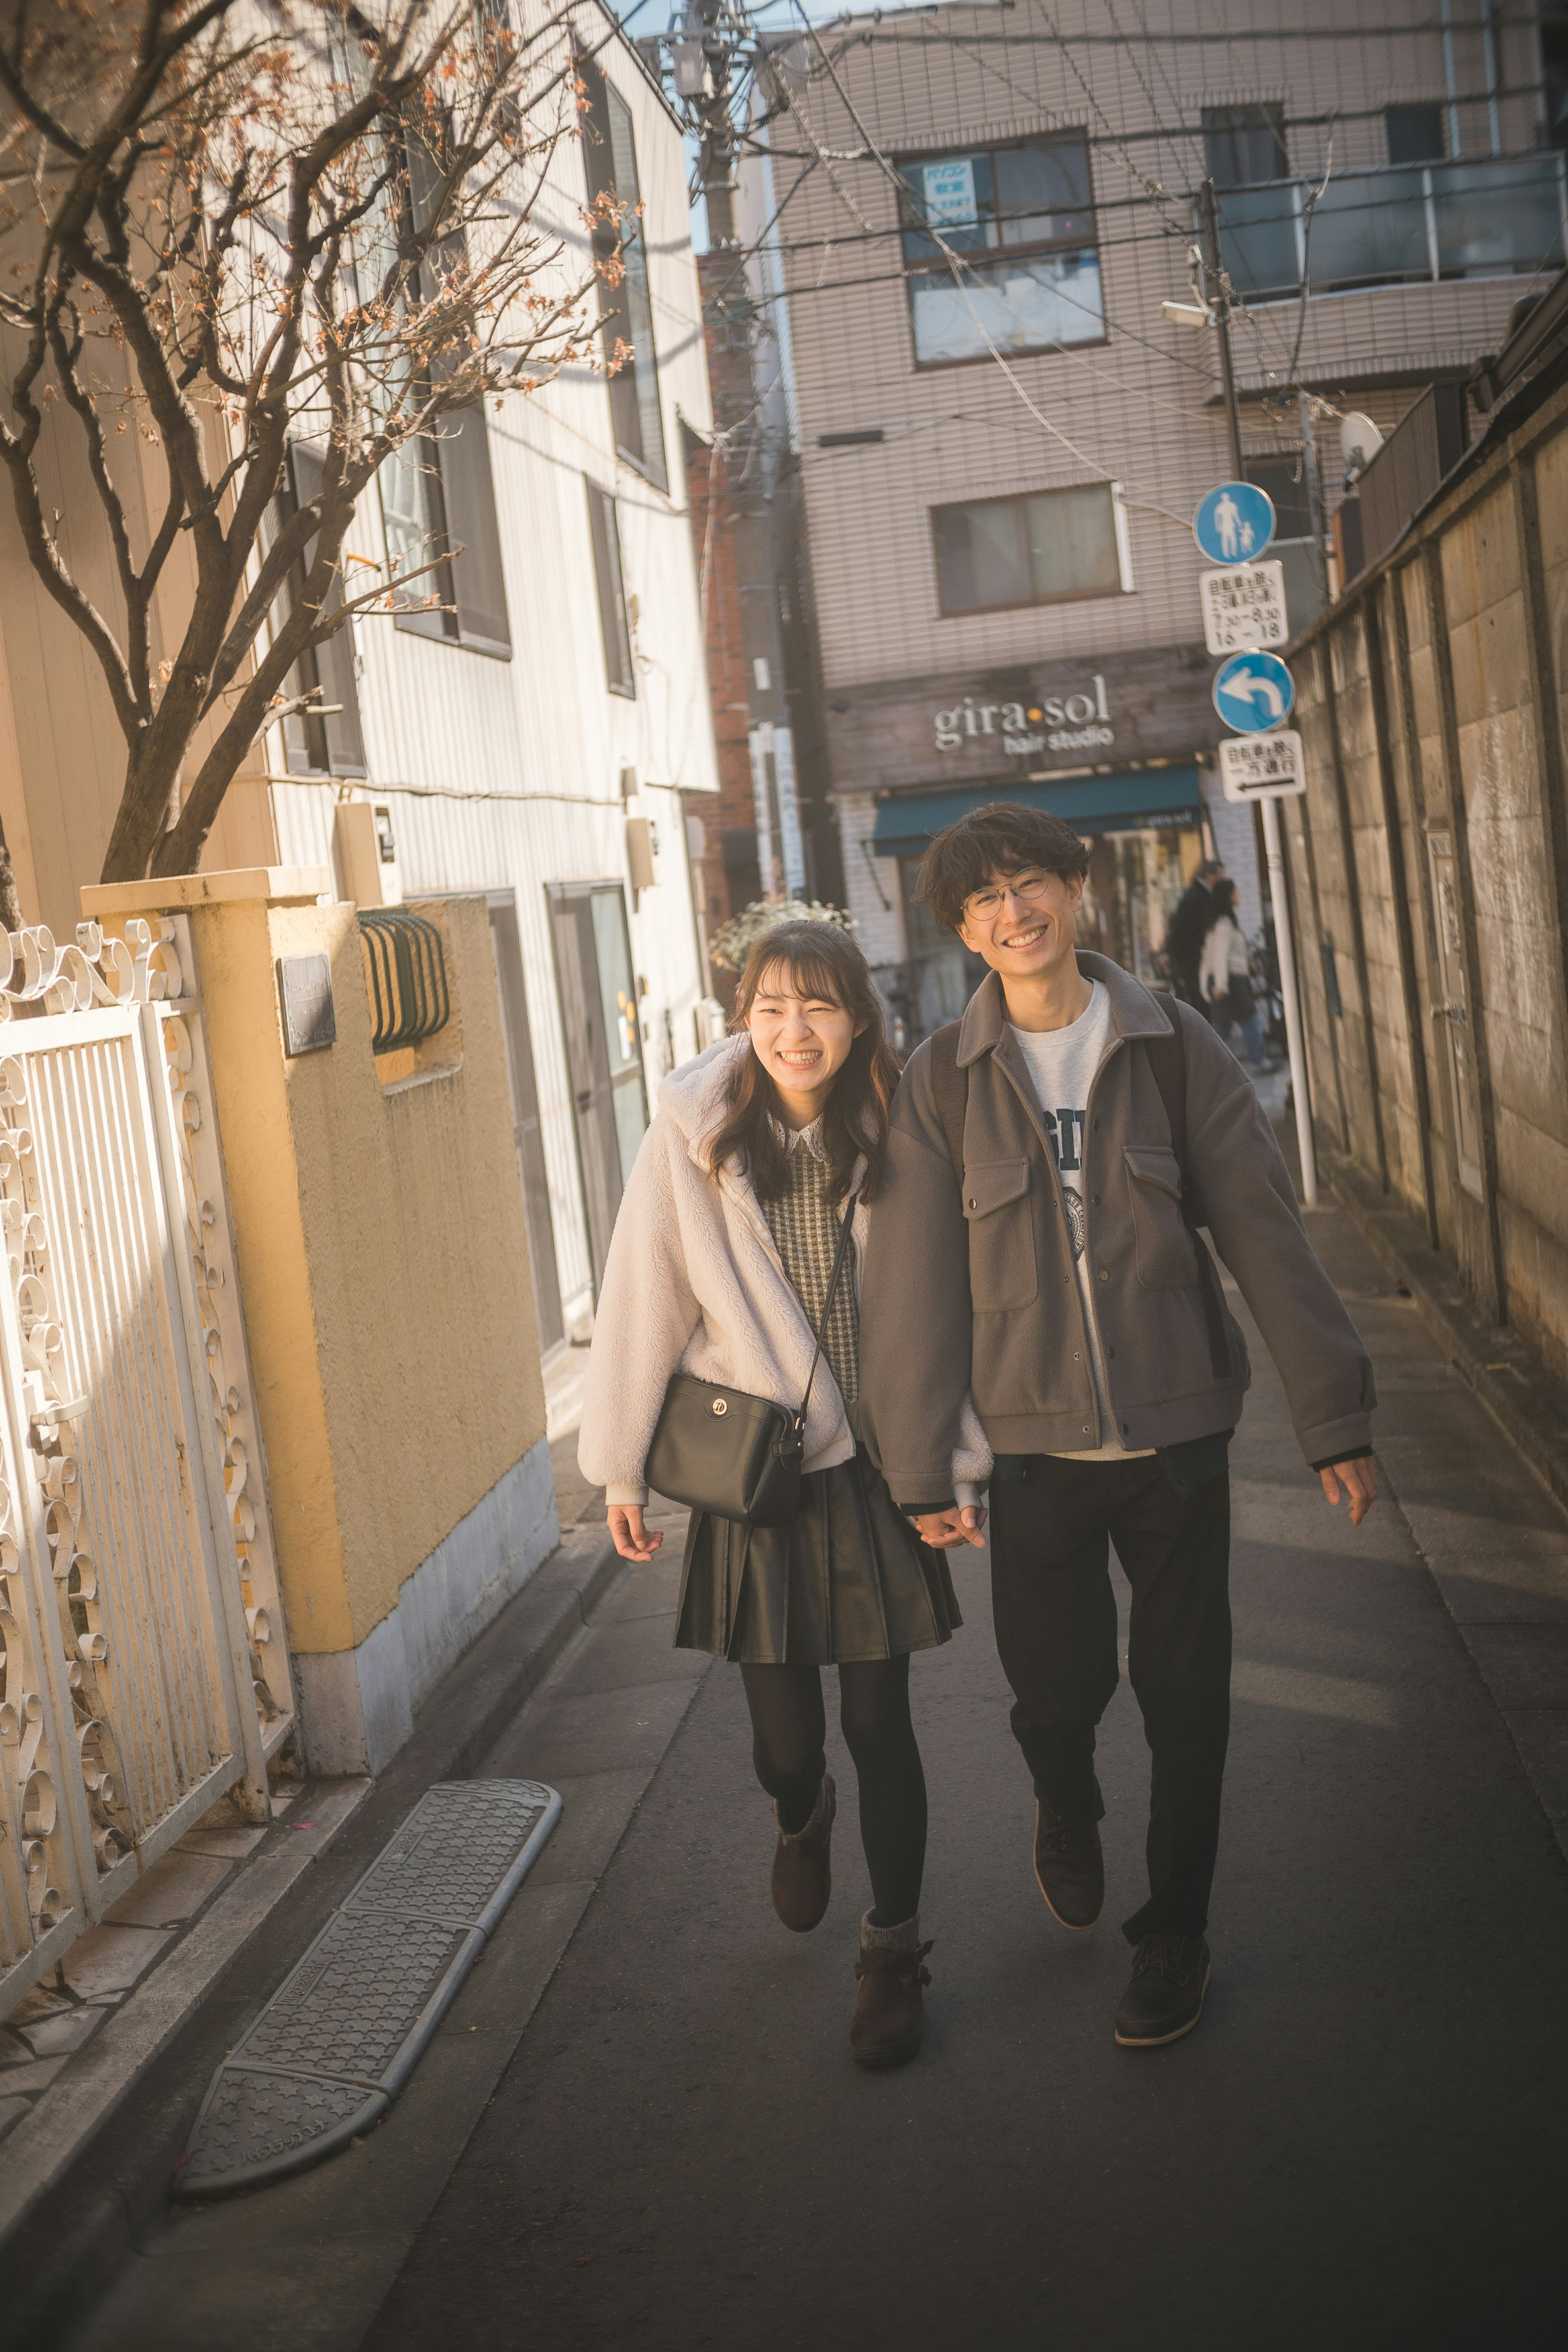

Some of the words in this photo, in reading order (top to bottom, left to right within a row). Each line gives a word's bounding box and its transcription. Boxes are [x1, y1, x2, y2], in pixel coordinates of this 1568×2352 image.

[1003, 732, 1045, 755] hair
[1047, 724, 1114, 752] studio
[1229, 755, 1296, 777] 一方通行
[1066, 1194, 1080, 1209] CLUB
